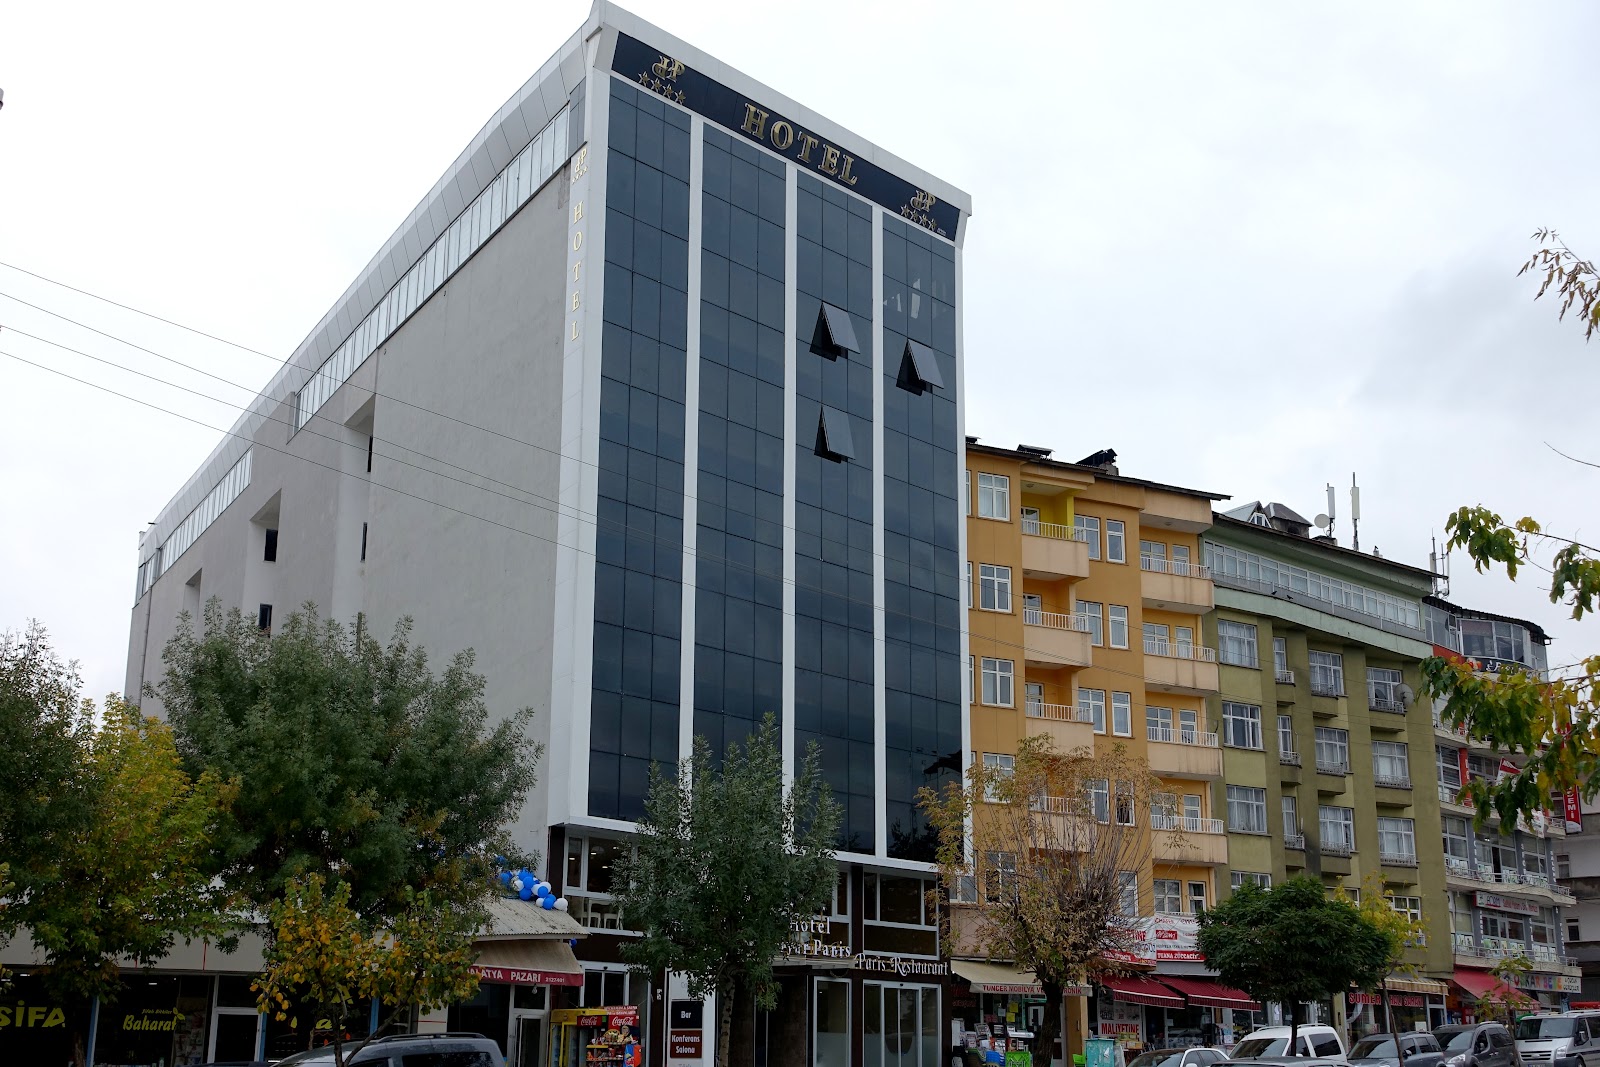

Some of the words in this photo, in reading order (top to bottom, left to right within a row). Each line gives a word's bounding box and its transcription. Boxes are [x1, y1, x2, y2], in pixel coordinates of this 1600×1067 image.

[741, 102, 859, 186] HOTEL
[571, 201, 584, 341] HOTEL
[790, 916, 831, 935] Hotel
[814, 939, 852, 960] Paris
[855, 953, 887, 971] Paris
[890, 956, 949, 977] Restaurant
[510, 971, 541, 983] PAZARI
[122, 1014, 178, 1031] Baharat
[680, 1010, 692, 1019] Bar
[671, 1034, 700, 1043] Konferans
